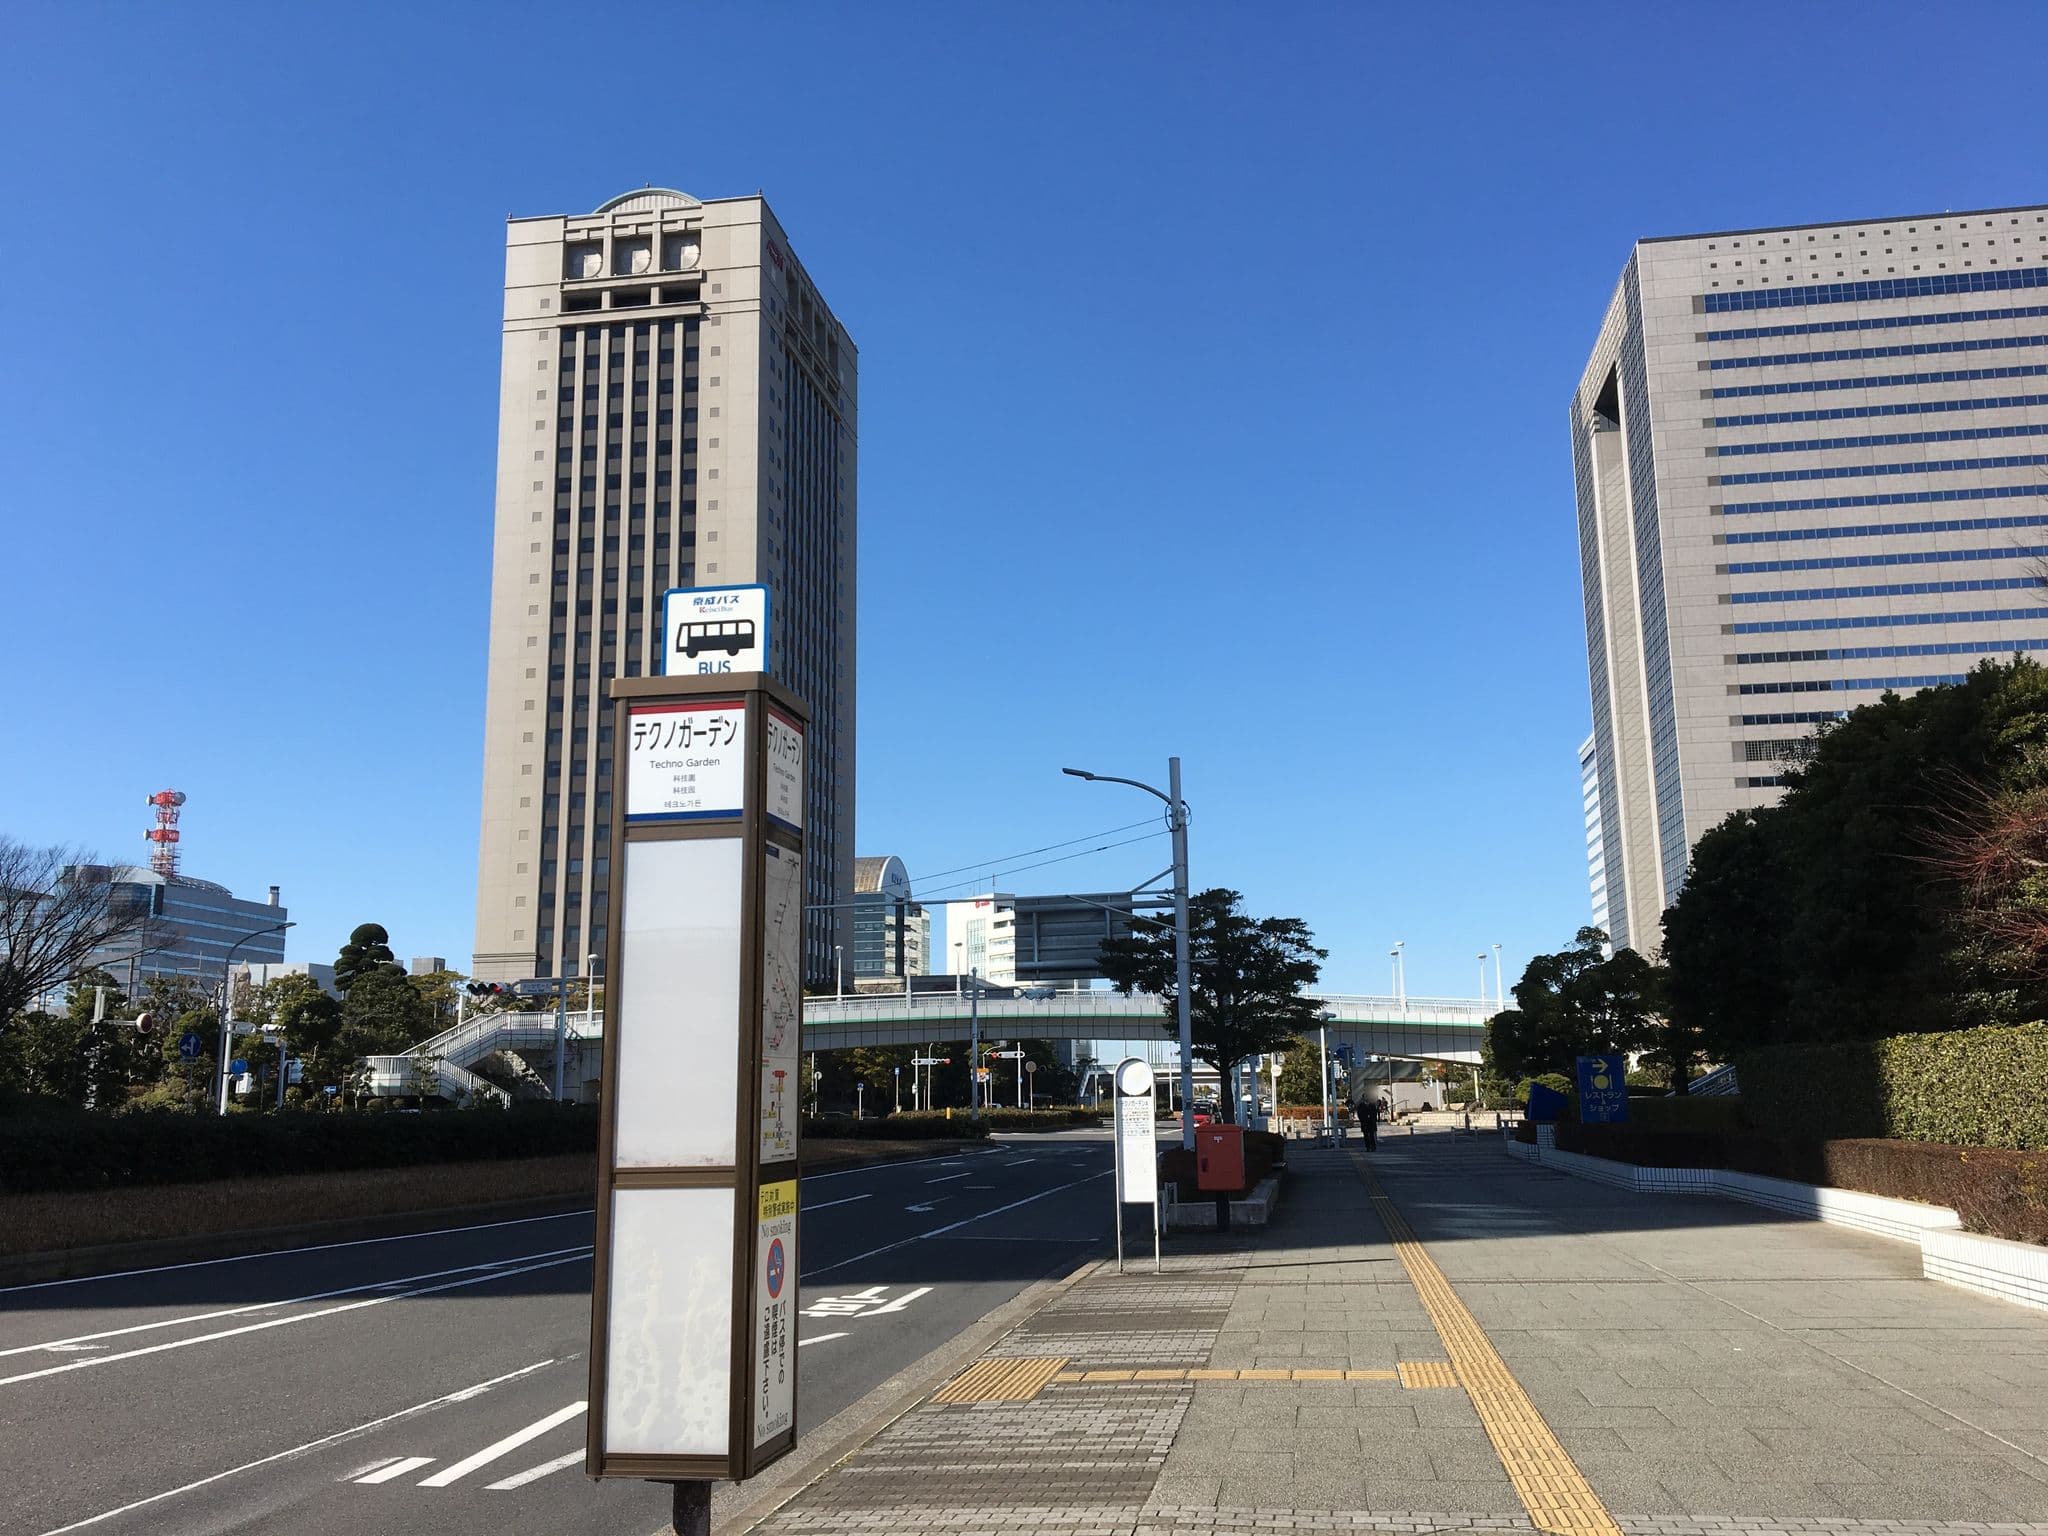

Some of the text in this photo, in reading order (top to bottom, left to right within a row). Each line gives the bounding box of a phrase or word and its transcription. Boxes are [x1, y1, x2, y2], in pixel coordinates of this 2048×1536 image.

[692, 595, 740, 606] 京成バス
[698, 660, 731, 675] BUS
[634, 717, 737, 750] テクノガーデン
[768, 722, 801, 766] テクノガーデン
[650, 757, 721, 769] Techno Garden
[1585, 1091, 1623, 1100] レストラン
[1589, 1104, 1619, 1112] ショップ
[760, 1219, 792, 1239] No smoking
[771, 1303, 779, 1356] 喫煙は
[777, 1300, 787, 1385] バス停での
[757, 1411, 789, 1438] No smoking
